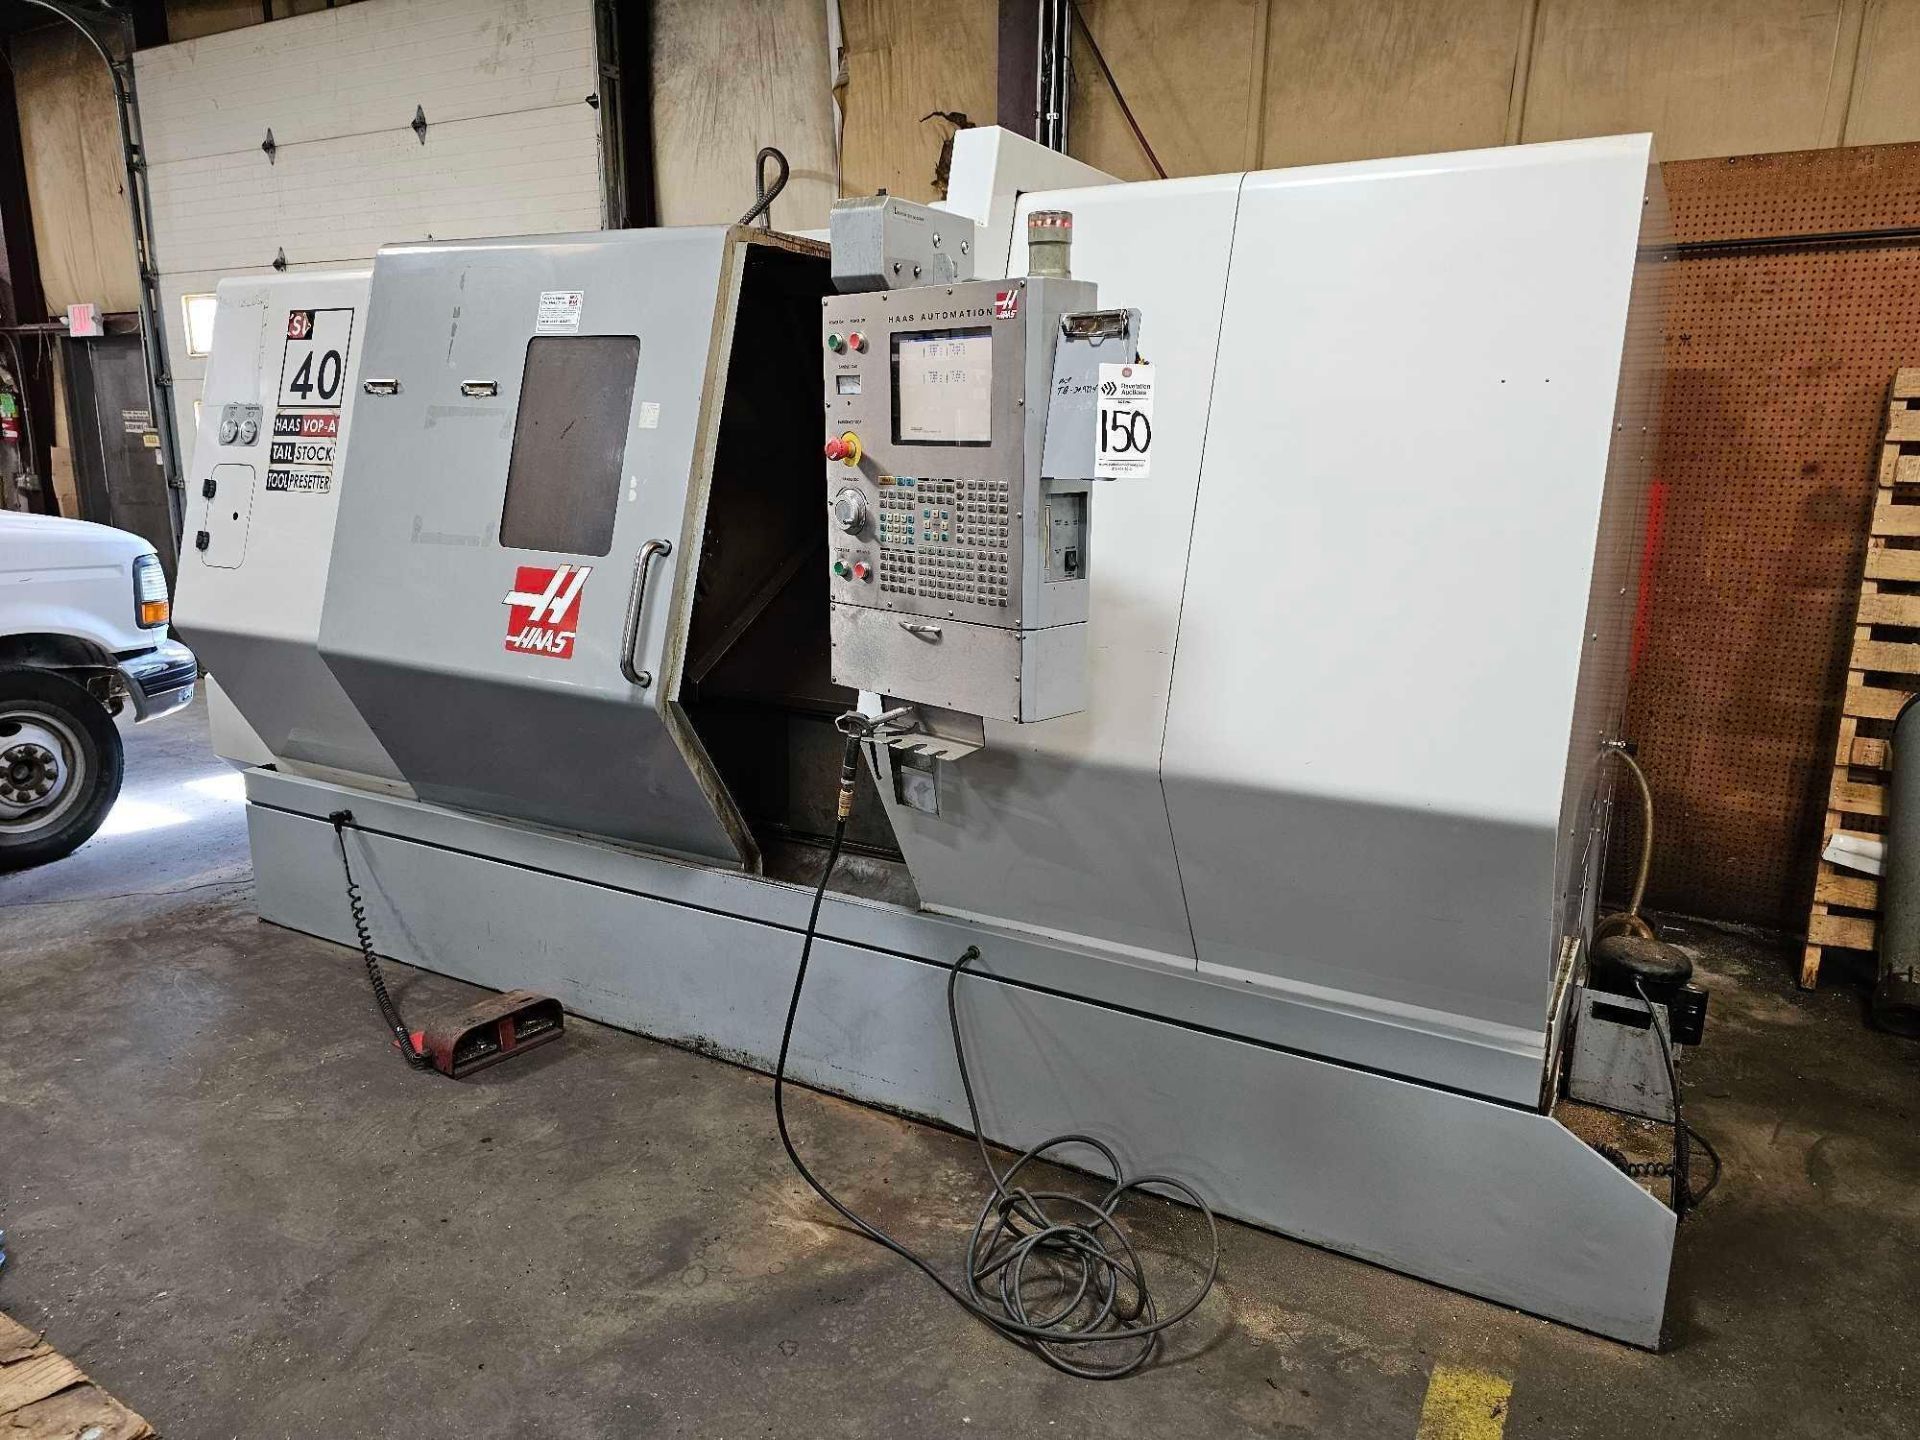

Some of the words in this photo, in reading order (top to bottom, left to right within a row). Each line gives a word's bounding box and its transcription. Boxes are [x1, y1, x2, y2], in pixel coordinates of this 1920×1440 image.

[888, 314, 914, 323] HAAS
[921, 308, 993, 321] AUTOMATION
[289, 350, 342, 400] 40
[275, 418, 301, 432] HAAS
[303, 418, 336, 433] VOP-A
[1101, 409, 1151, 453] 150
[273, 445, 293, 460] TAIL
[295, 446, 333, 461] STOCK
[268, 473, 288, 488] TOOL
[288, 473, 330, 490] PRESETTER
[506, 626, 576, 653] HAAS
